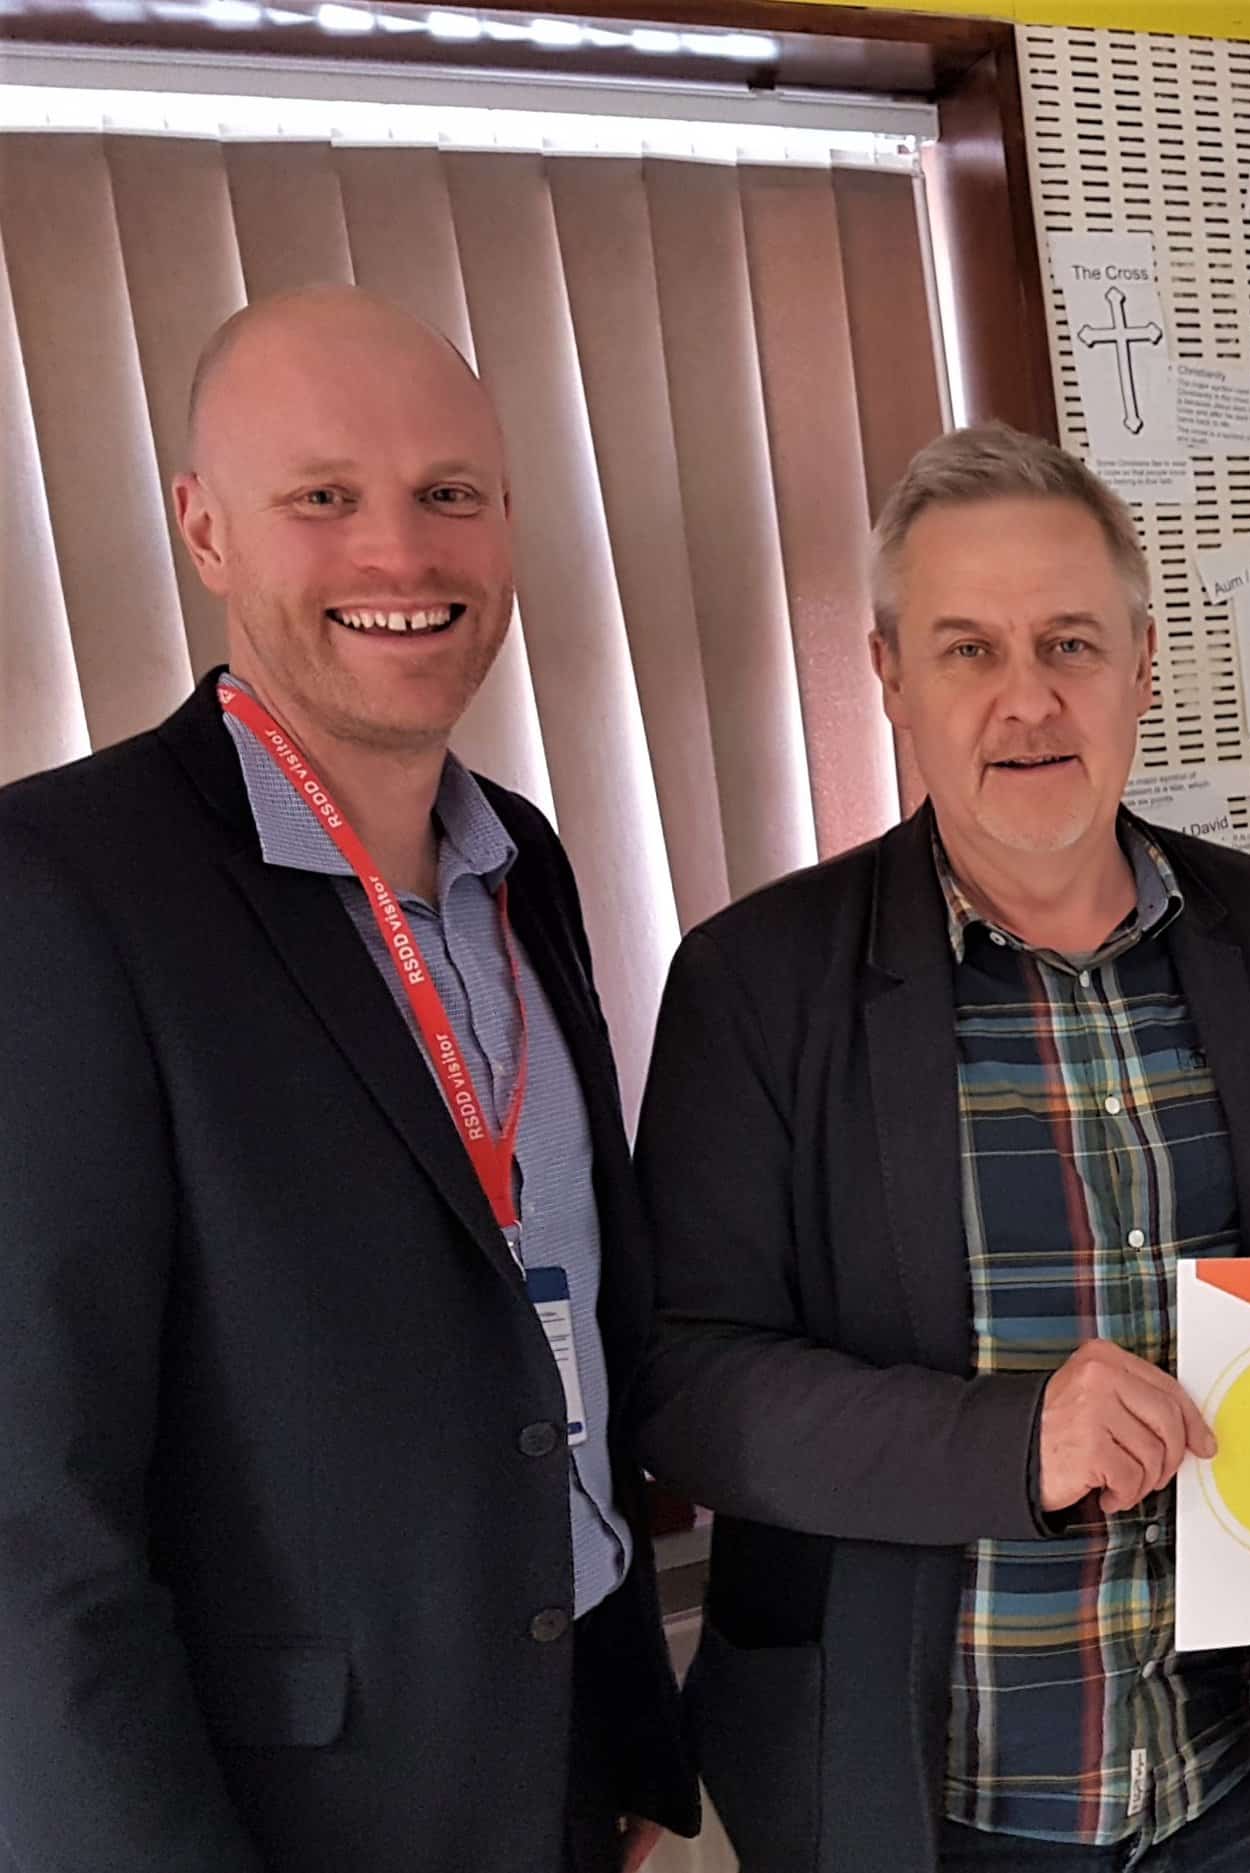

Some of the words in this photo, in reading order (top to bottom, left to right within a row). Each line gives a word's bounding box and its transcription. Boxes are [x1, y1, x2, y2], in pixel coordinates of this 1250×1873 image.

[1072, 265, 1101, 280] The
[1105, 265, 1149, 281] Cross
[1215, 576, 1244, 597] Aum
[265, 729, 308, 779] visitor
[304, 781, 342, 829] RSDD
[1191, 816, 1229, 835] David
[368, 876, 402, 931] visitor
[393, 933, 425, 985] RSDD
[435, 1033, 465, 1088] visitor
[456, 1091, 485, 1140] RSDD
